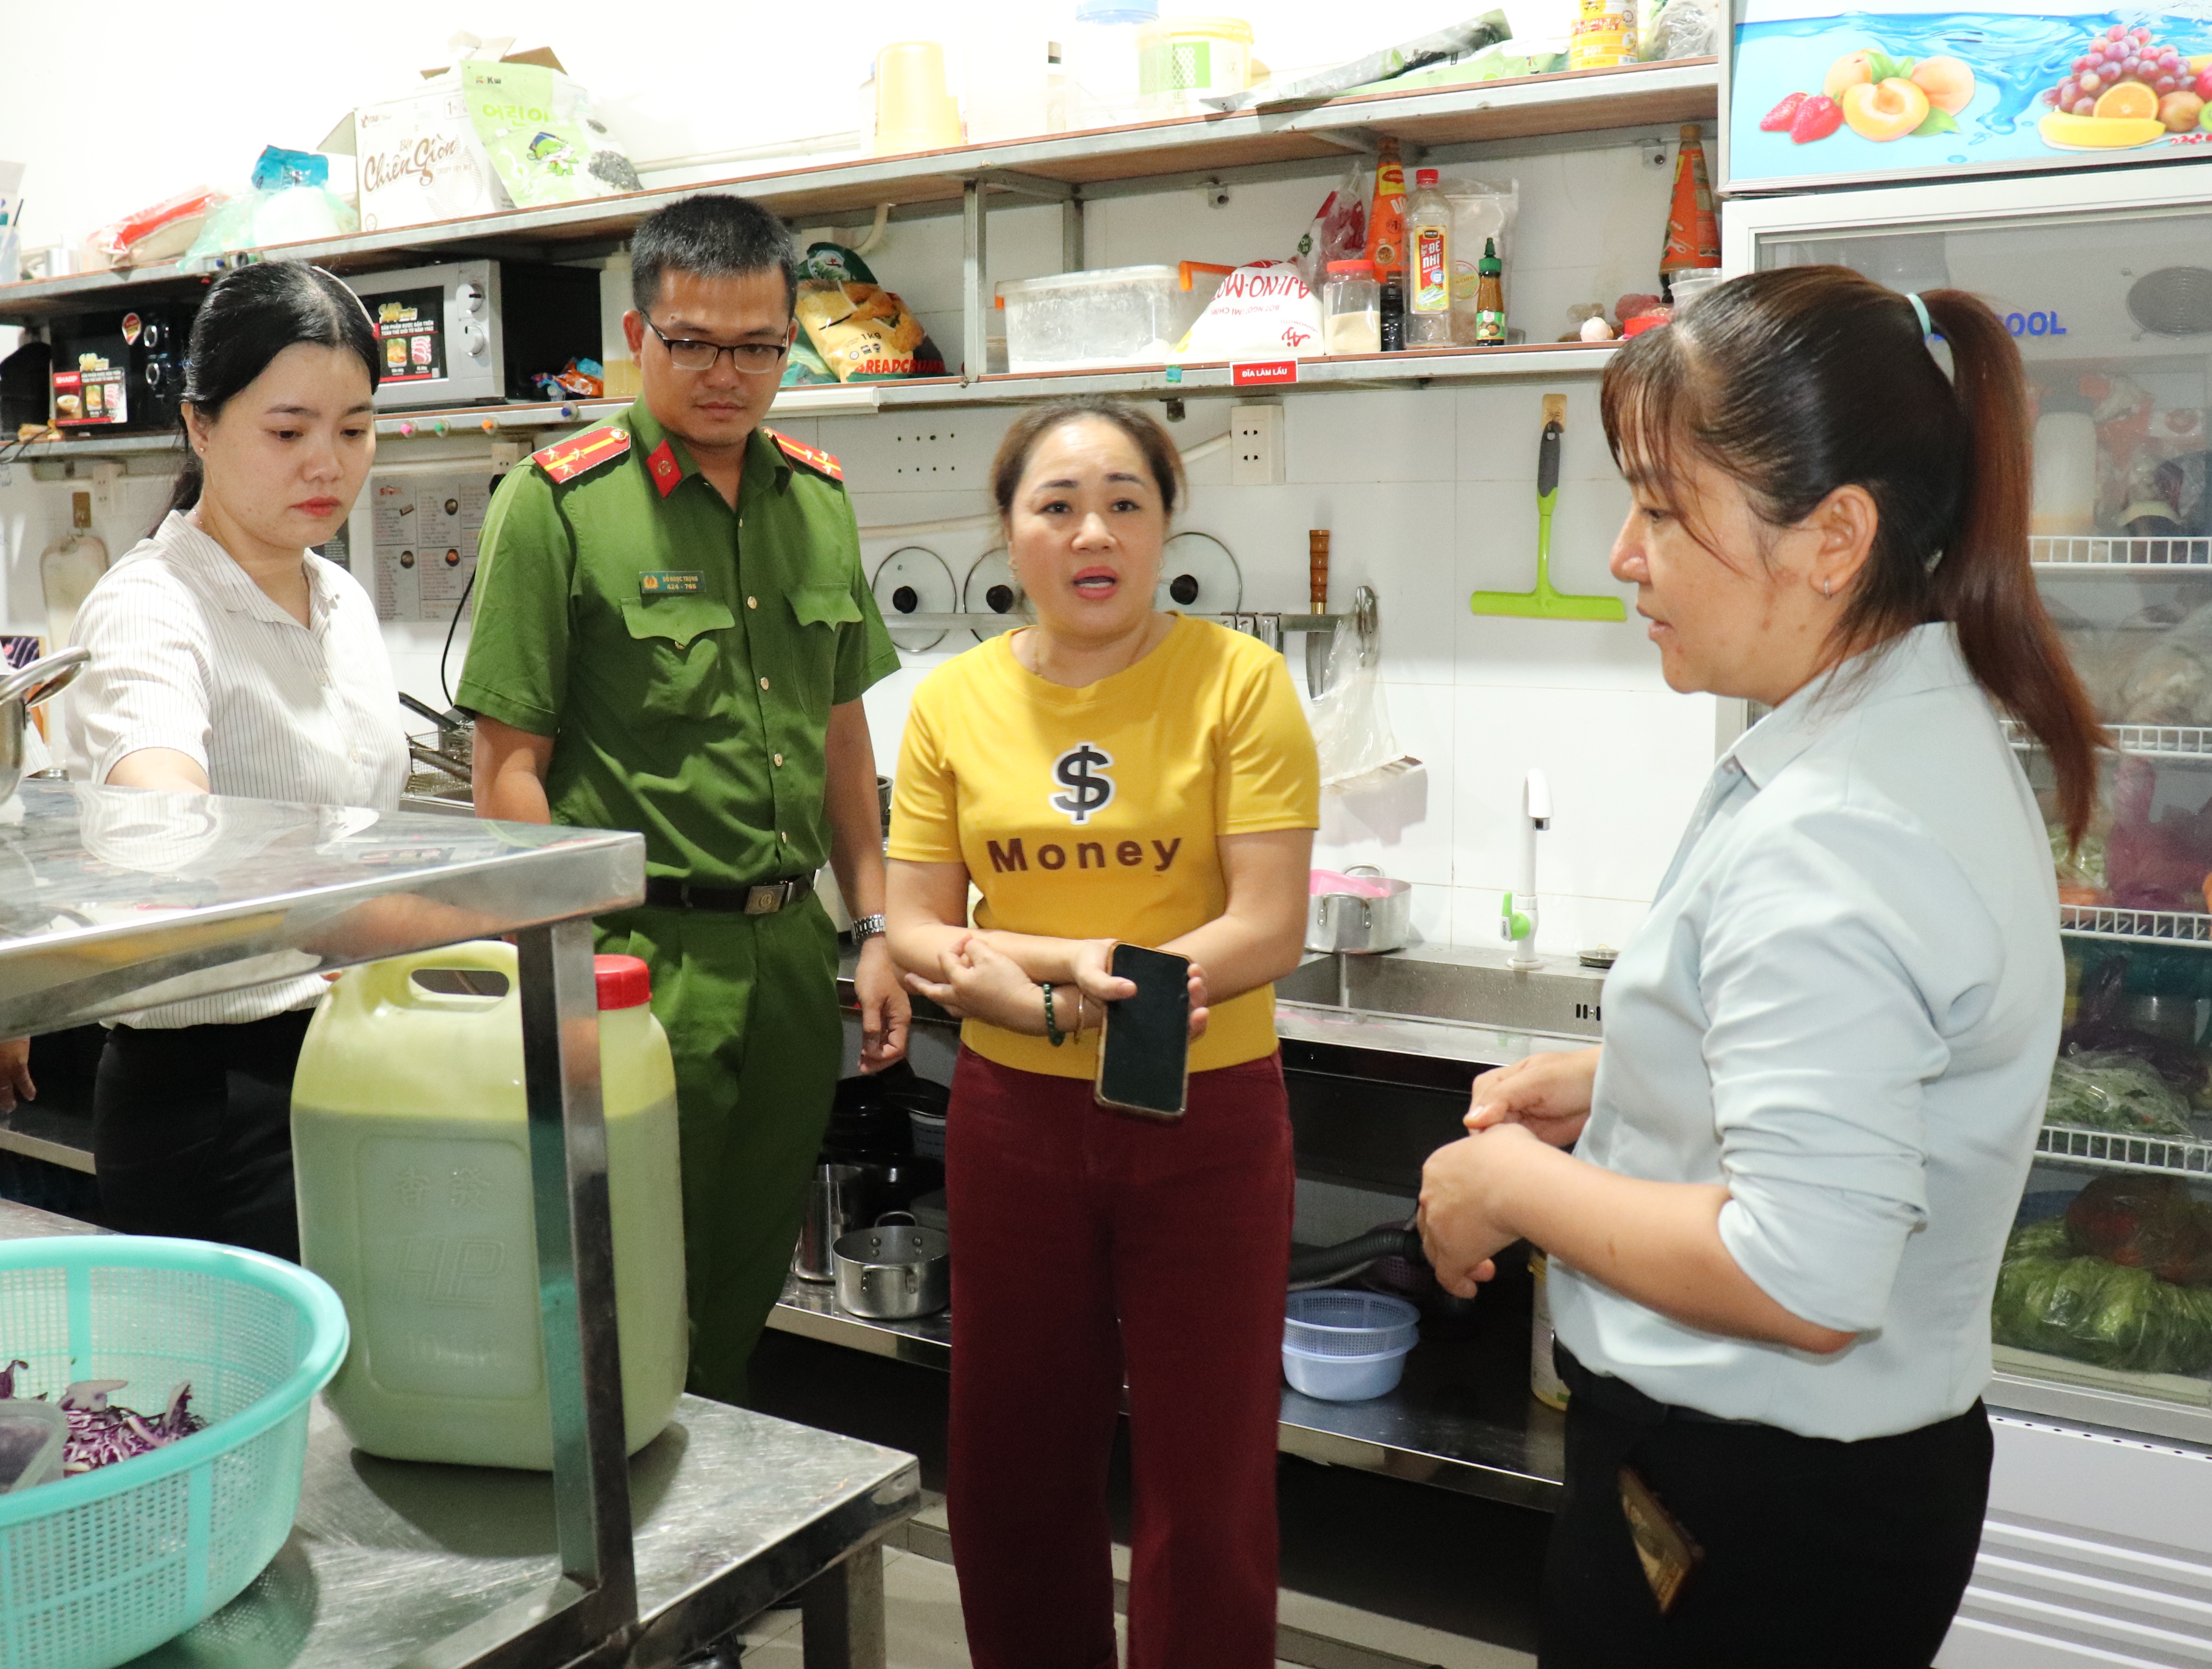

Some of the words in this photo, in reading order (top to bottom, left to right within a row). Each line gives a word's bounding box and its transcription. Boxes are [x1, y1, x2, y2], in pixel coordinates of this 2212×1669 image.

[1994, 311, 2067, 337] OOL
[55, 375, 78, 384] SHARP
[1242, 369, 1255, 377] ĐĨA
[1256, 368, 1271, 377] LÀM
[1053, 744, 1111, 821] $
[987, 837, 1183, 874] Money
